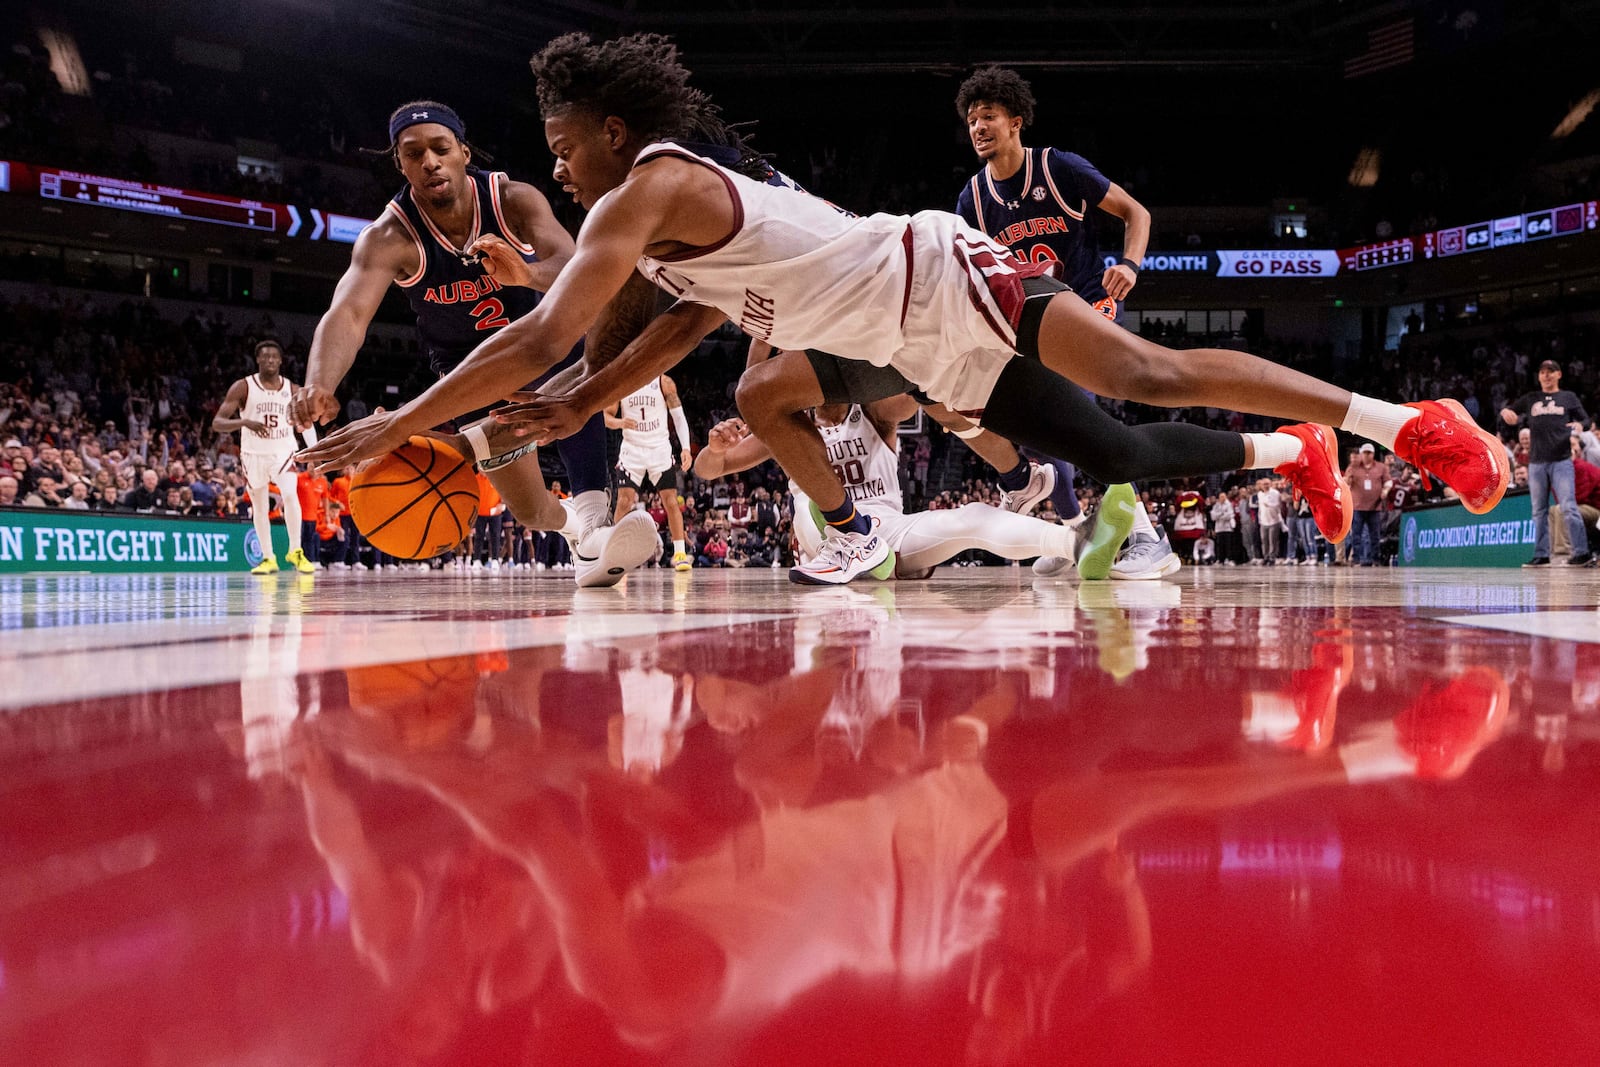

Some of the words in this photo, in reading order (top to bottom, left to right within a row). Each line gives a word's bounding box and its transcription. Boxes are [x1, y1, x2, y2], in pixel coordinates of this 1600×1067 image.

[1527, 218, 1552, 234] 64
[1467, 230, 1489, 245] 63
[1140, 256, 1208, 271] MONTH
[1242, 252, 1314, 260] GAMECOCK
[1235, 260, 1264, 274] GO
[1270, 260, 1323, 274] PASS
[424, 275, 503, 304] AUBU
[469, 297, 510, 330] 2
[256, 402, 285, 415] SOUTH
[629, 396, 656, 408] SOUTH
[263, 414, 278, 428] 15
[640, 407, 645, 421] 1
[1393, 490, 1405, 507] 9
[1418, 529, 1434, 548] OLD
[1434, 525, 1477, 548] DOMINION
[1478, 521, 1520, 545] FREIGHT
[33, 527, 165, 561] FREIGHT
[172, 532, 229, 561] LINE
